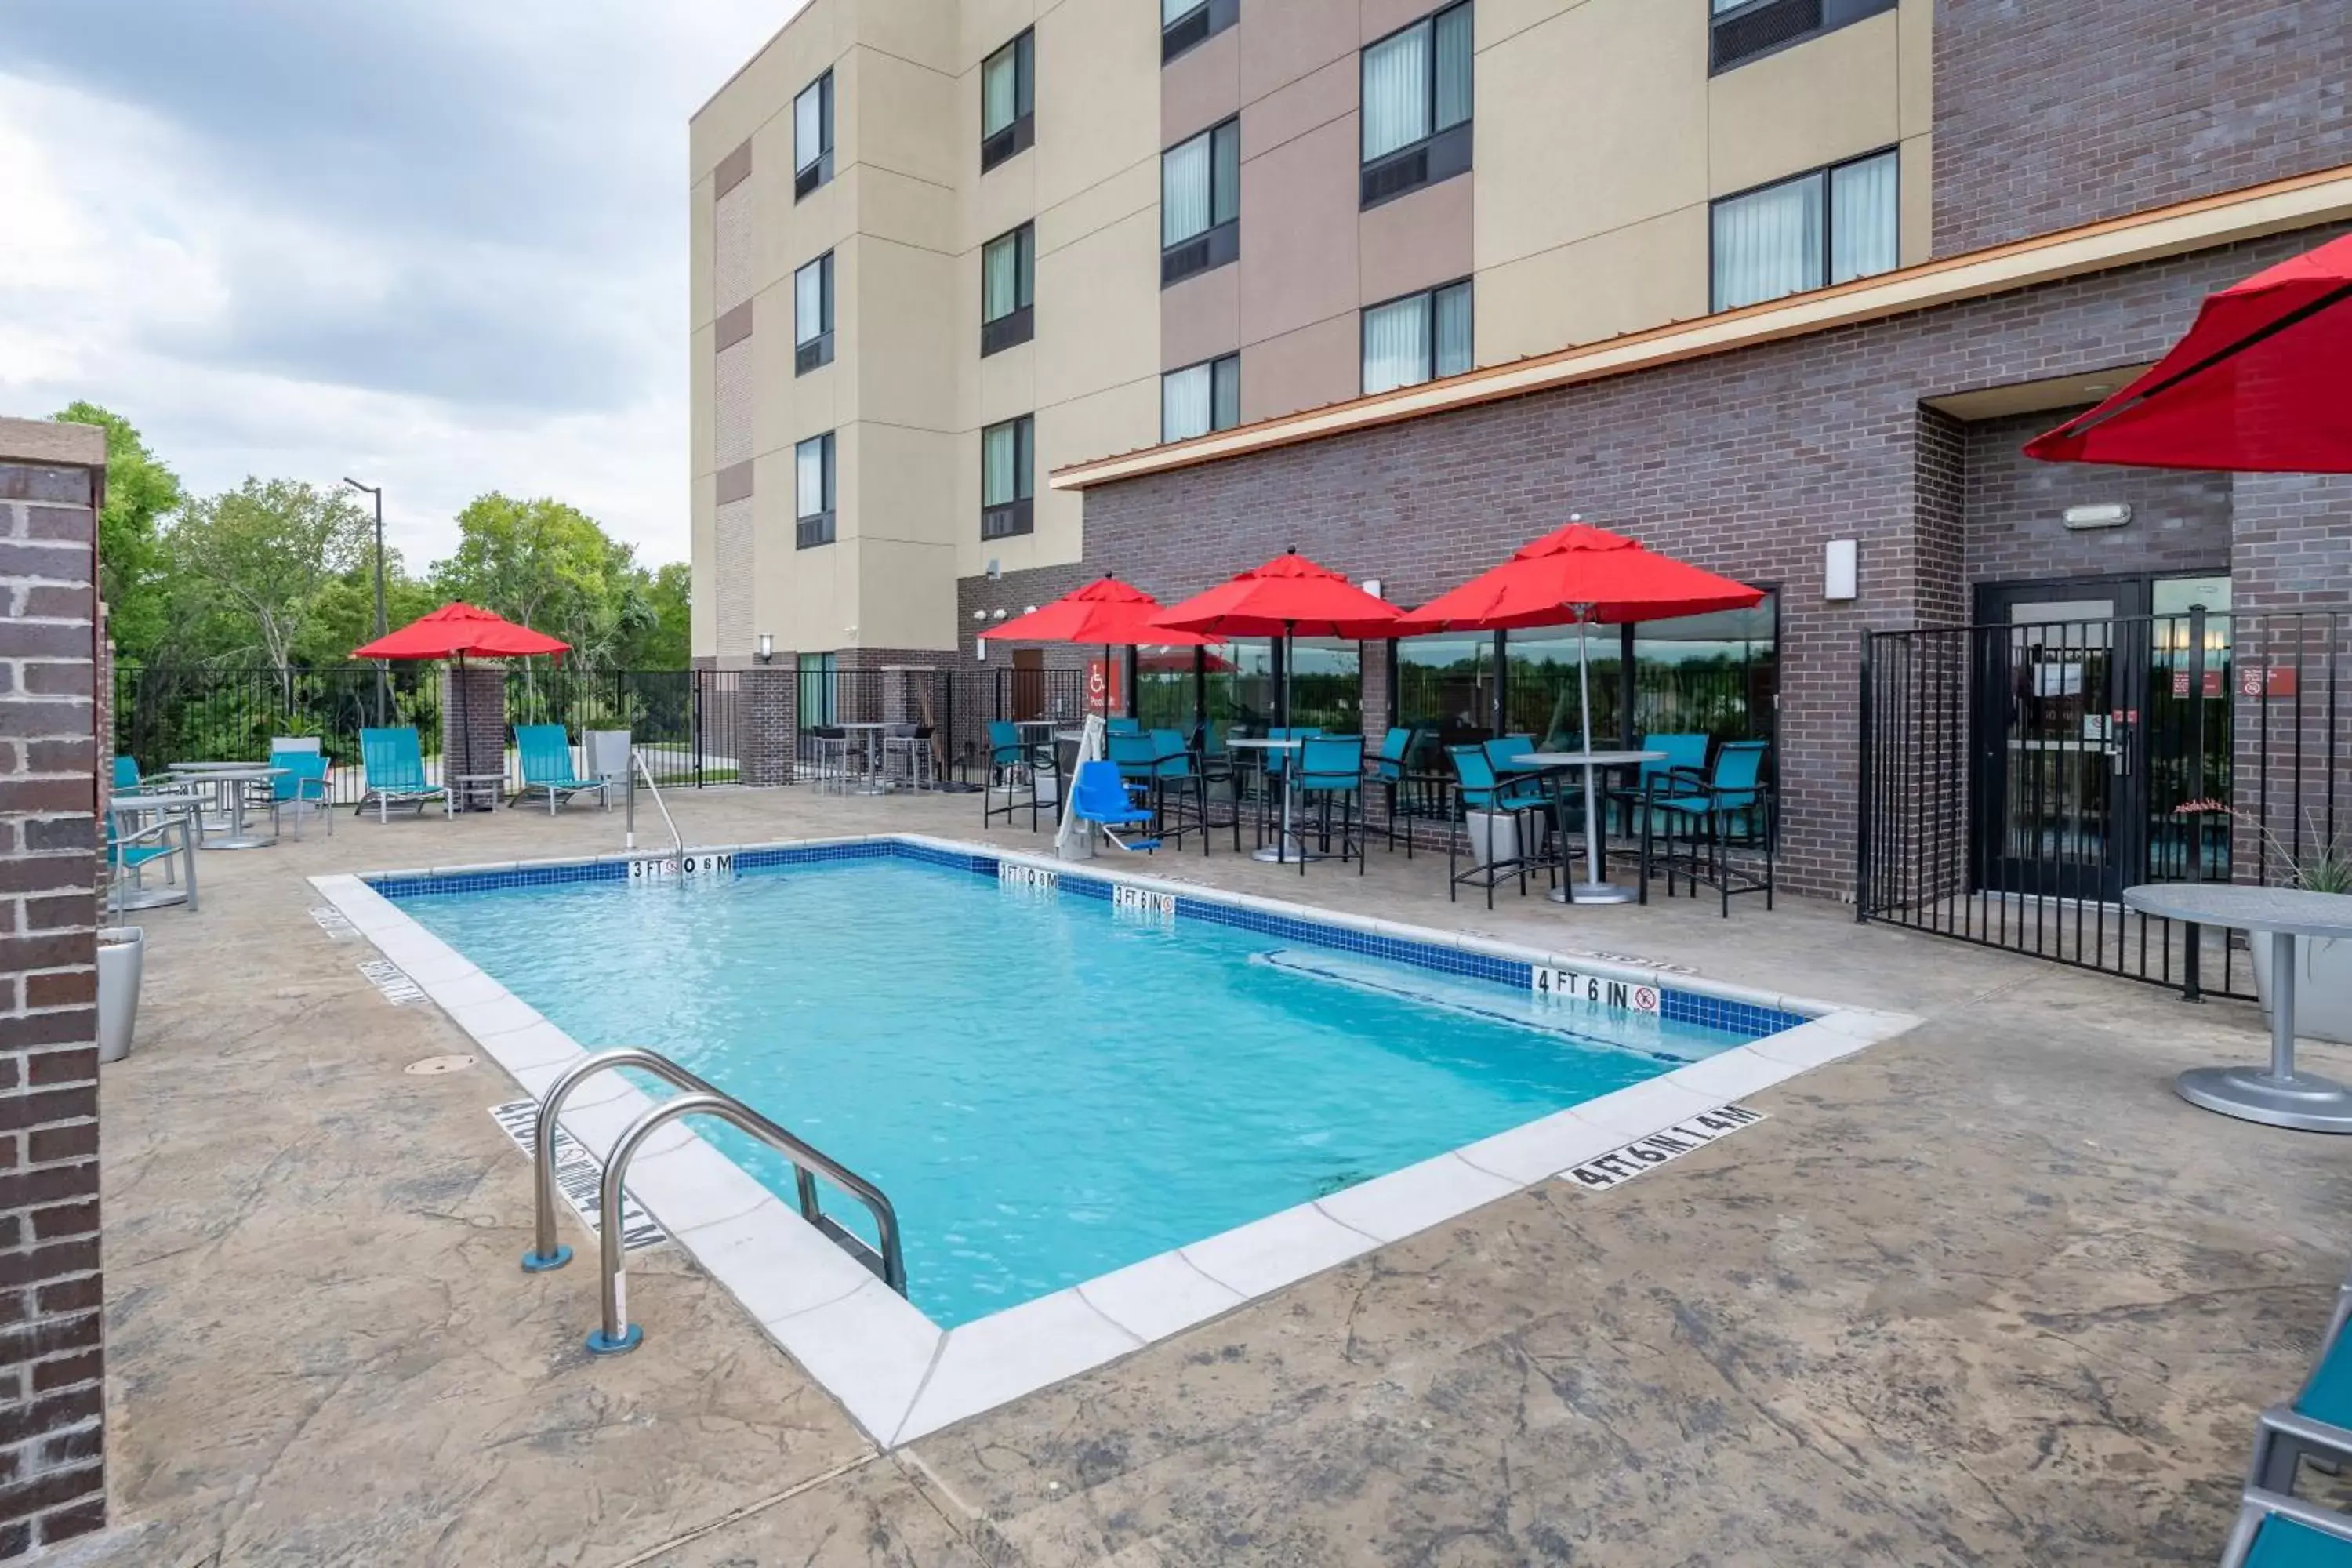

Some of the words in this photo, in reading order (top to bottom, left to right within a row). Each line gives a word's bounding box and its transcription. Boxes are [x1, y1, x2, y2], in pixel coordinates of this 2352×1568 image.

[634, 861, 642, 877] 3
[647, 860, 663, 877] FT
[717, 855, 731, 876] M
[1125, 889, 1136, 905] FT
[1141, 891, 1147, 909] 6
[1538, 970, 1549, 993] 4
[1557, 971, 1578, 993] FT
[1588, 978, 1599, 1001] 6
